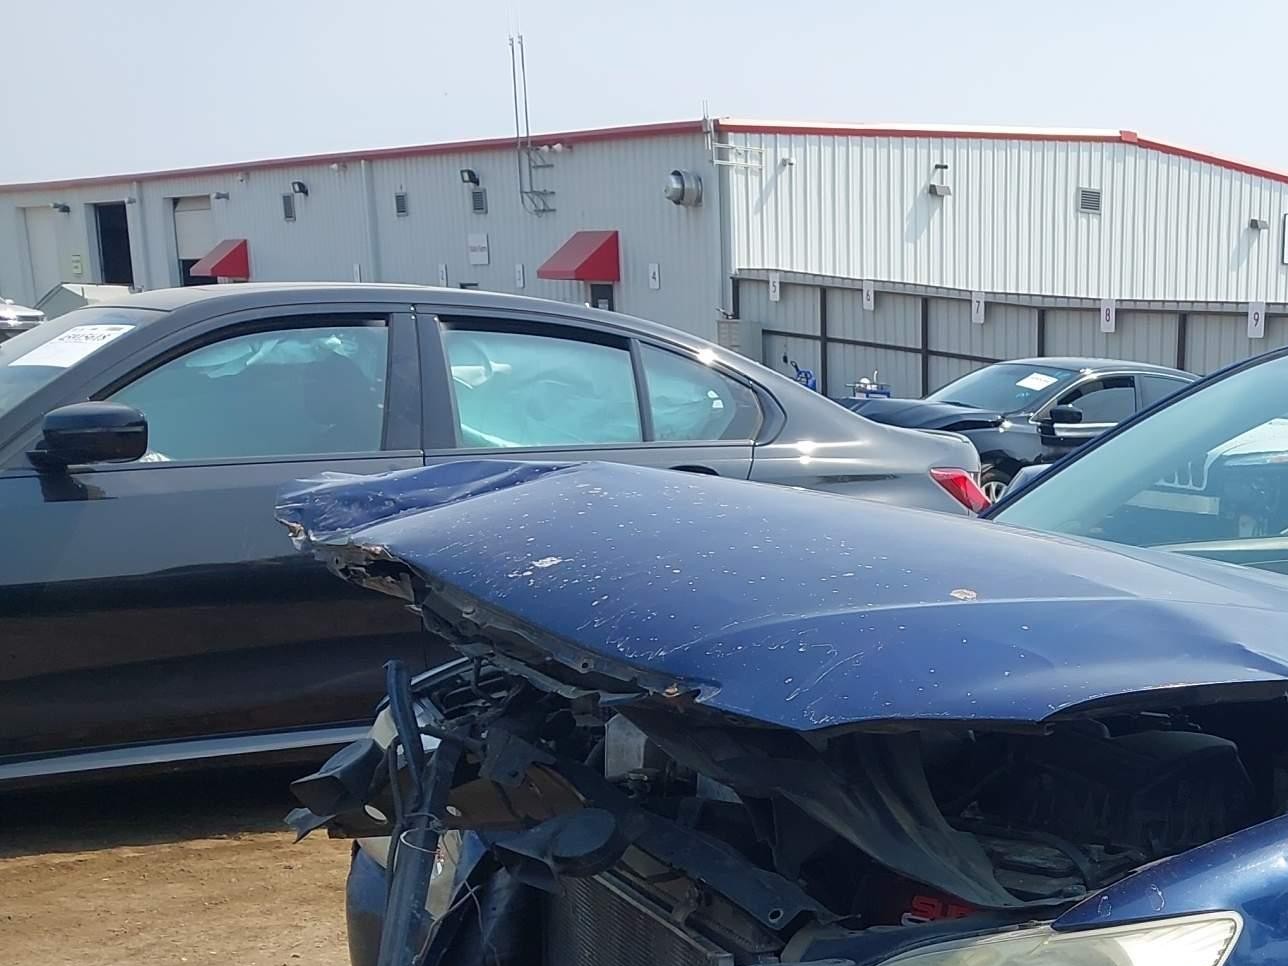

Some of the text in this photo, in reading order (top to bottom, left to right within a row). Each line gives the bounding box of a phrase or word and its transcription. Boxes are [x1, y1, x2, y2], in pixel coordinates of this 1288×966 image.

[975, 301, 981, 314] 7
[1104, 307, 1111, 322] 8
[1253, 311, 1260, 327] 9
